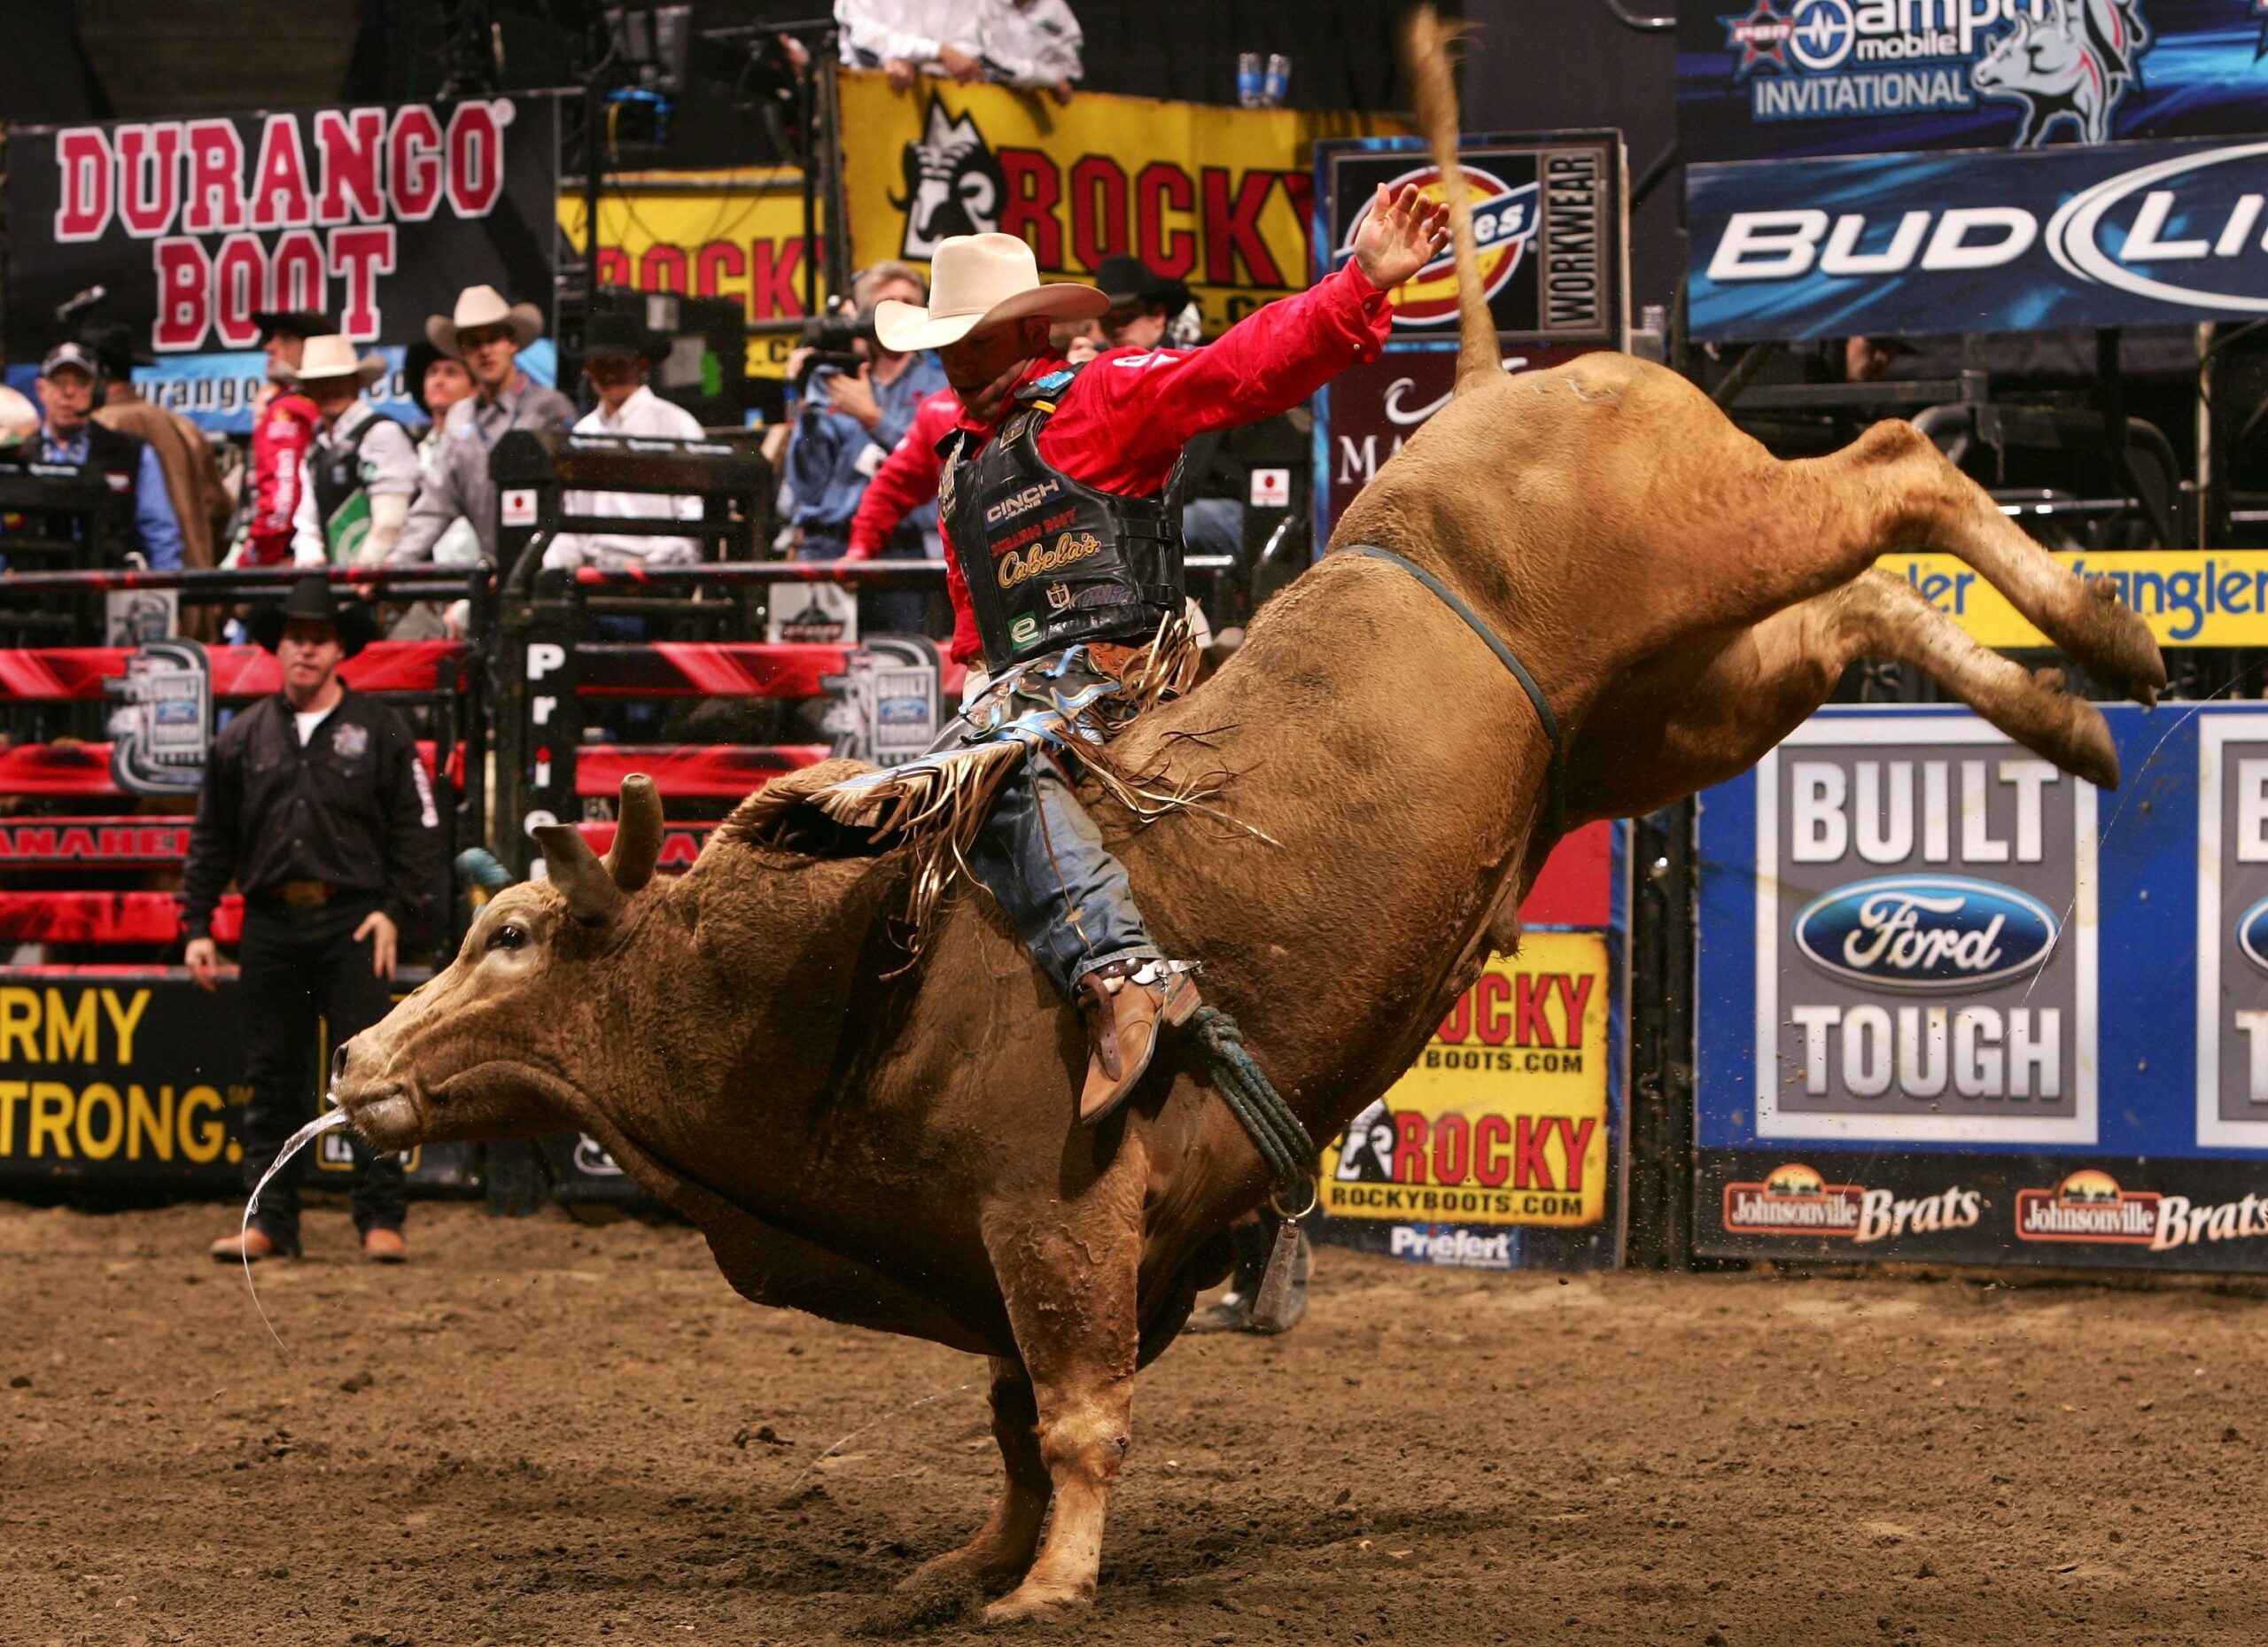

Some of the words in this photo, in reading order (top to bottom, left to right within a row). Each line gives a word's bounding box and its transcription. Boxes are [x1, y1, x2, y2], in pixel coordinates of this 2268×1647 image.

[1857, 29, 1958, 60] mobile
[1755, 68, 1970, 115] INVITATIONAL
[55, 99, 504, 242] DURANGO
[1550, 153, 1595, 326] WORKWEAR
[1707, 207, 2038, 280] BUD
[152, 224, 396, 352] BOOT
[596, 238, 827, 321] ROCK
[987, 478, 1060, 523] CINCH
[998, 532, 1101, 589] Cabela's
[2073, 560, 2268, 640] ngler
[1792, 760, 2059, 863] BUILT
[1843, 891, 2006, 971] Ford
[1437, 973, 1594, 1049] OCKY
[1414, 1049, 1583, 1073] BOOTS.COM
[1791, 1005, 2062, 1099] TOUGH
[1392, 1111, 1596, 1193] ROCKY
[1331, 1186, 1583, 1216] ROCKYBOOTS.COM
[1731, 1192, 1859, 1227] Johnsonville
[1854, 1185, 1981, 1243] Brats
[2023, 1197, 2155, 1236] Johnsonville
[1390, 1226, 1511, 1259] Priefert
